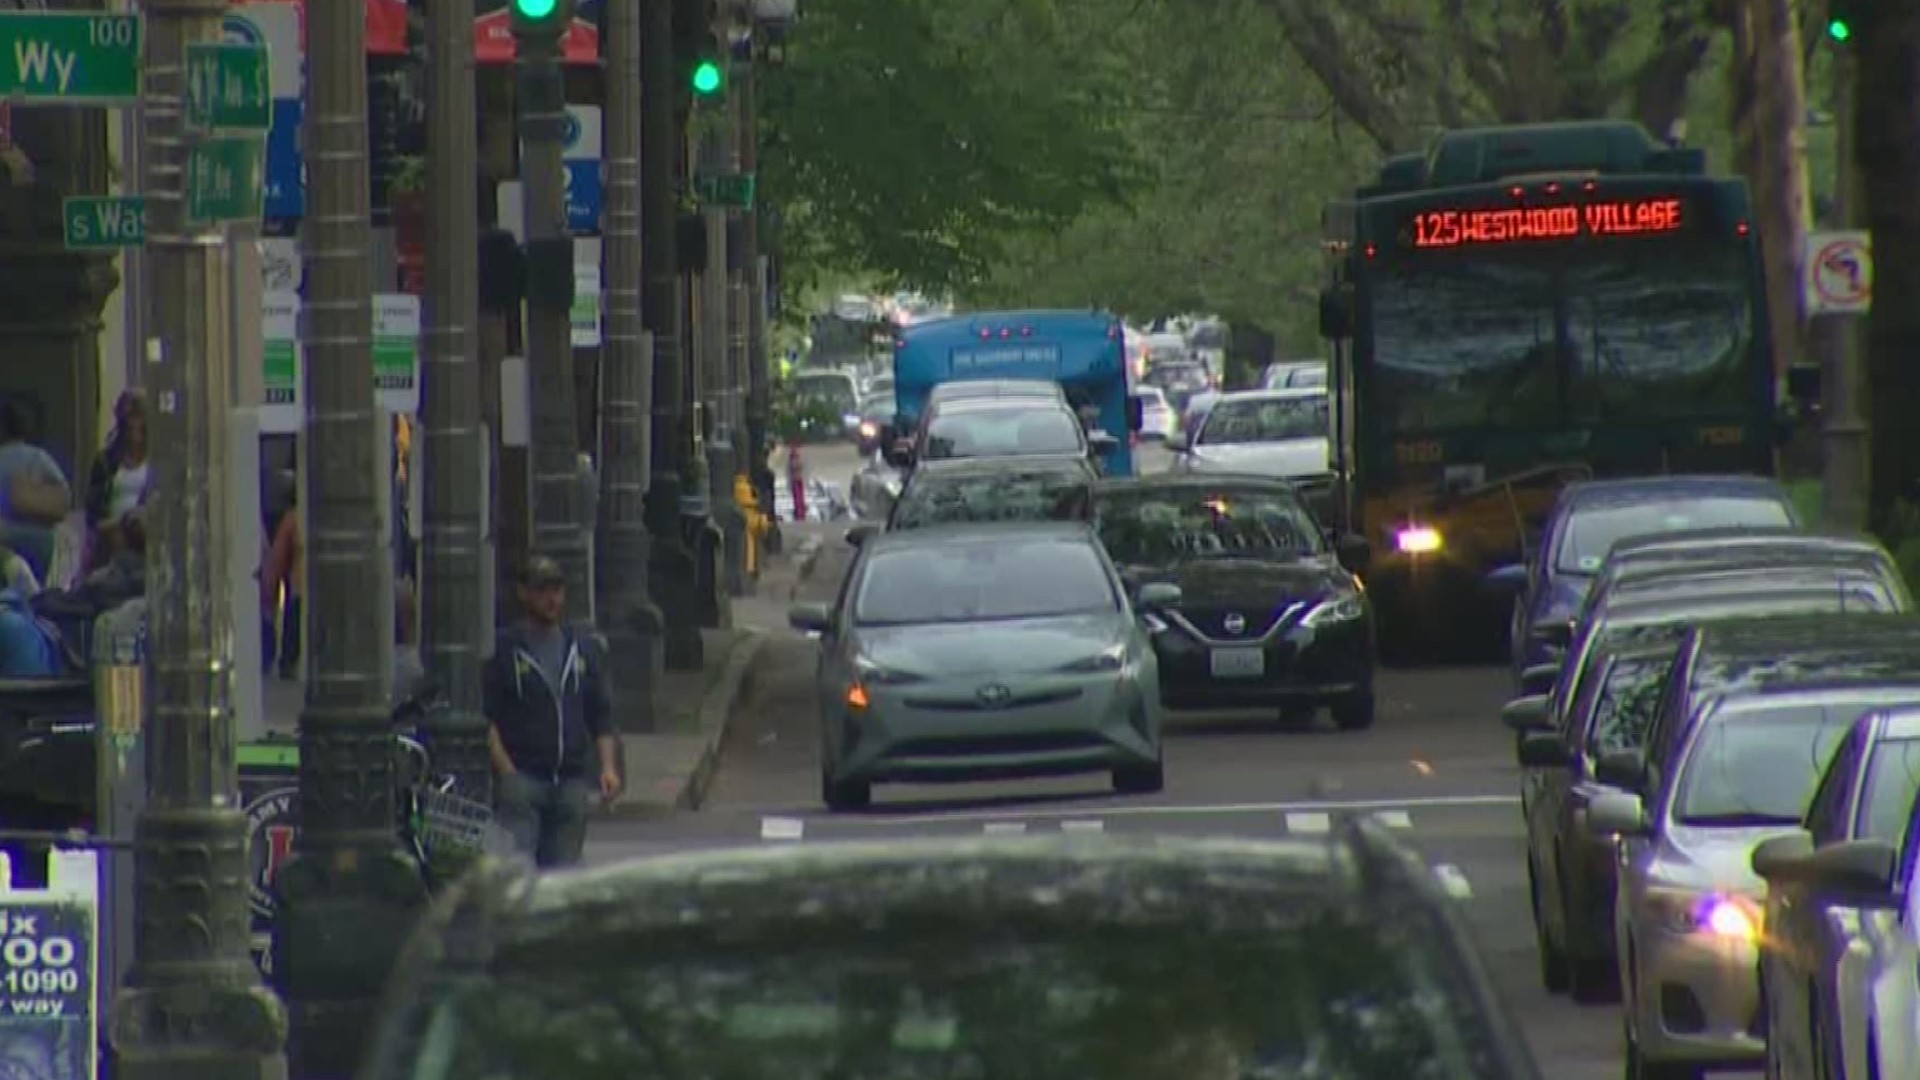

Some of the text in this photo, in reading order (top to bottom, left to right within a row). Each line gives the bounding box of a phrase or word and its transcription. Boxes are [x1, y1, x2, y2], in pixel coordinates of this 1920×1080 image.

[90, 20, 131, 46] 100
[15, 41, 76, 96] Wy
[1415, 201, 1680, 247] 125 WESTWOOD VILLAGE
[0, 937, 74, 967] 00
[0, 969, 78, 993] 1090
